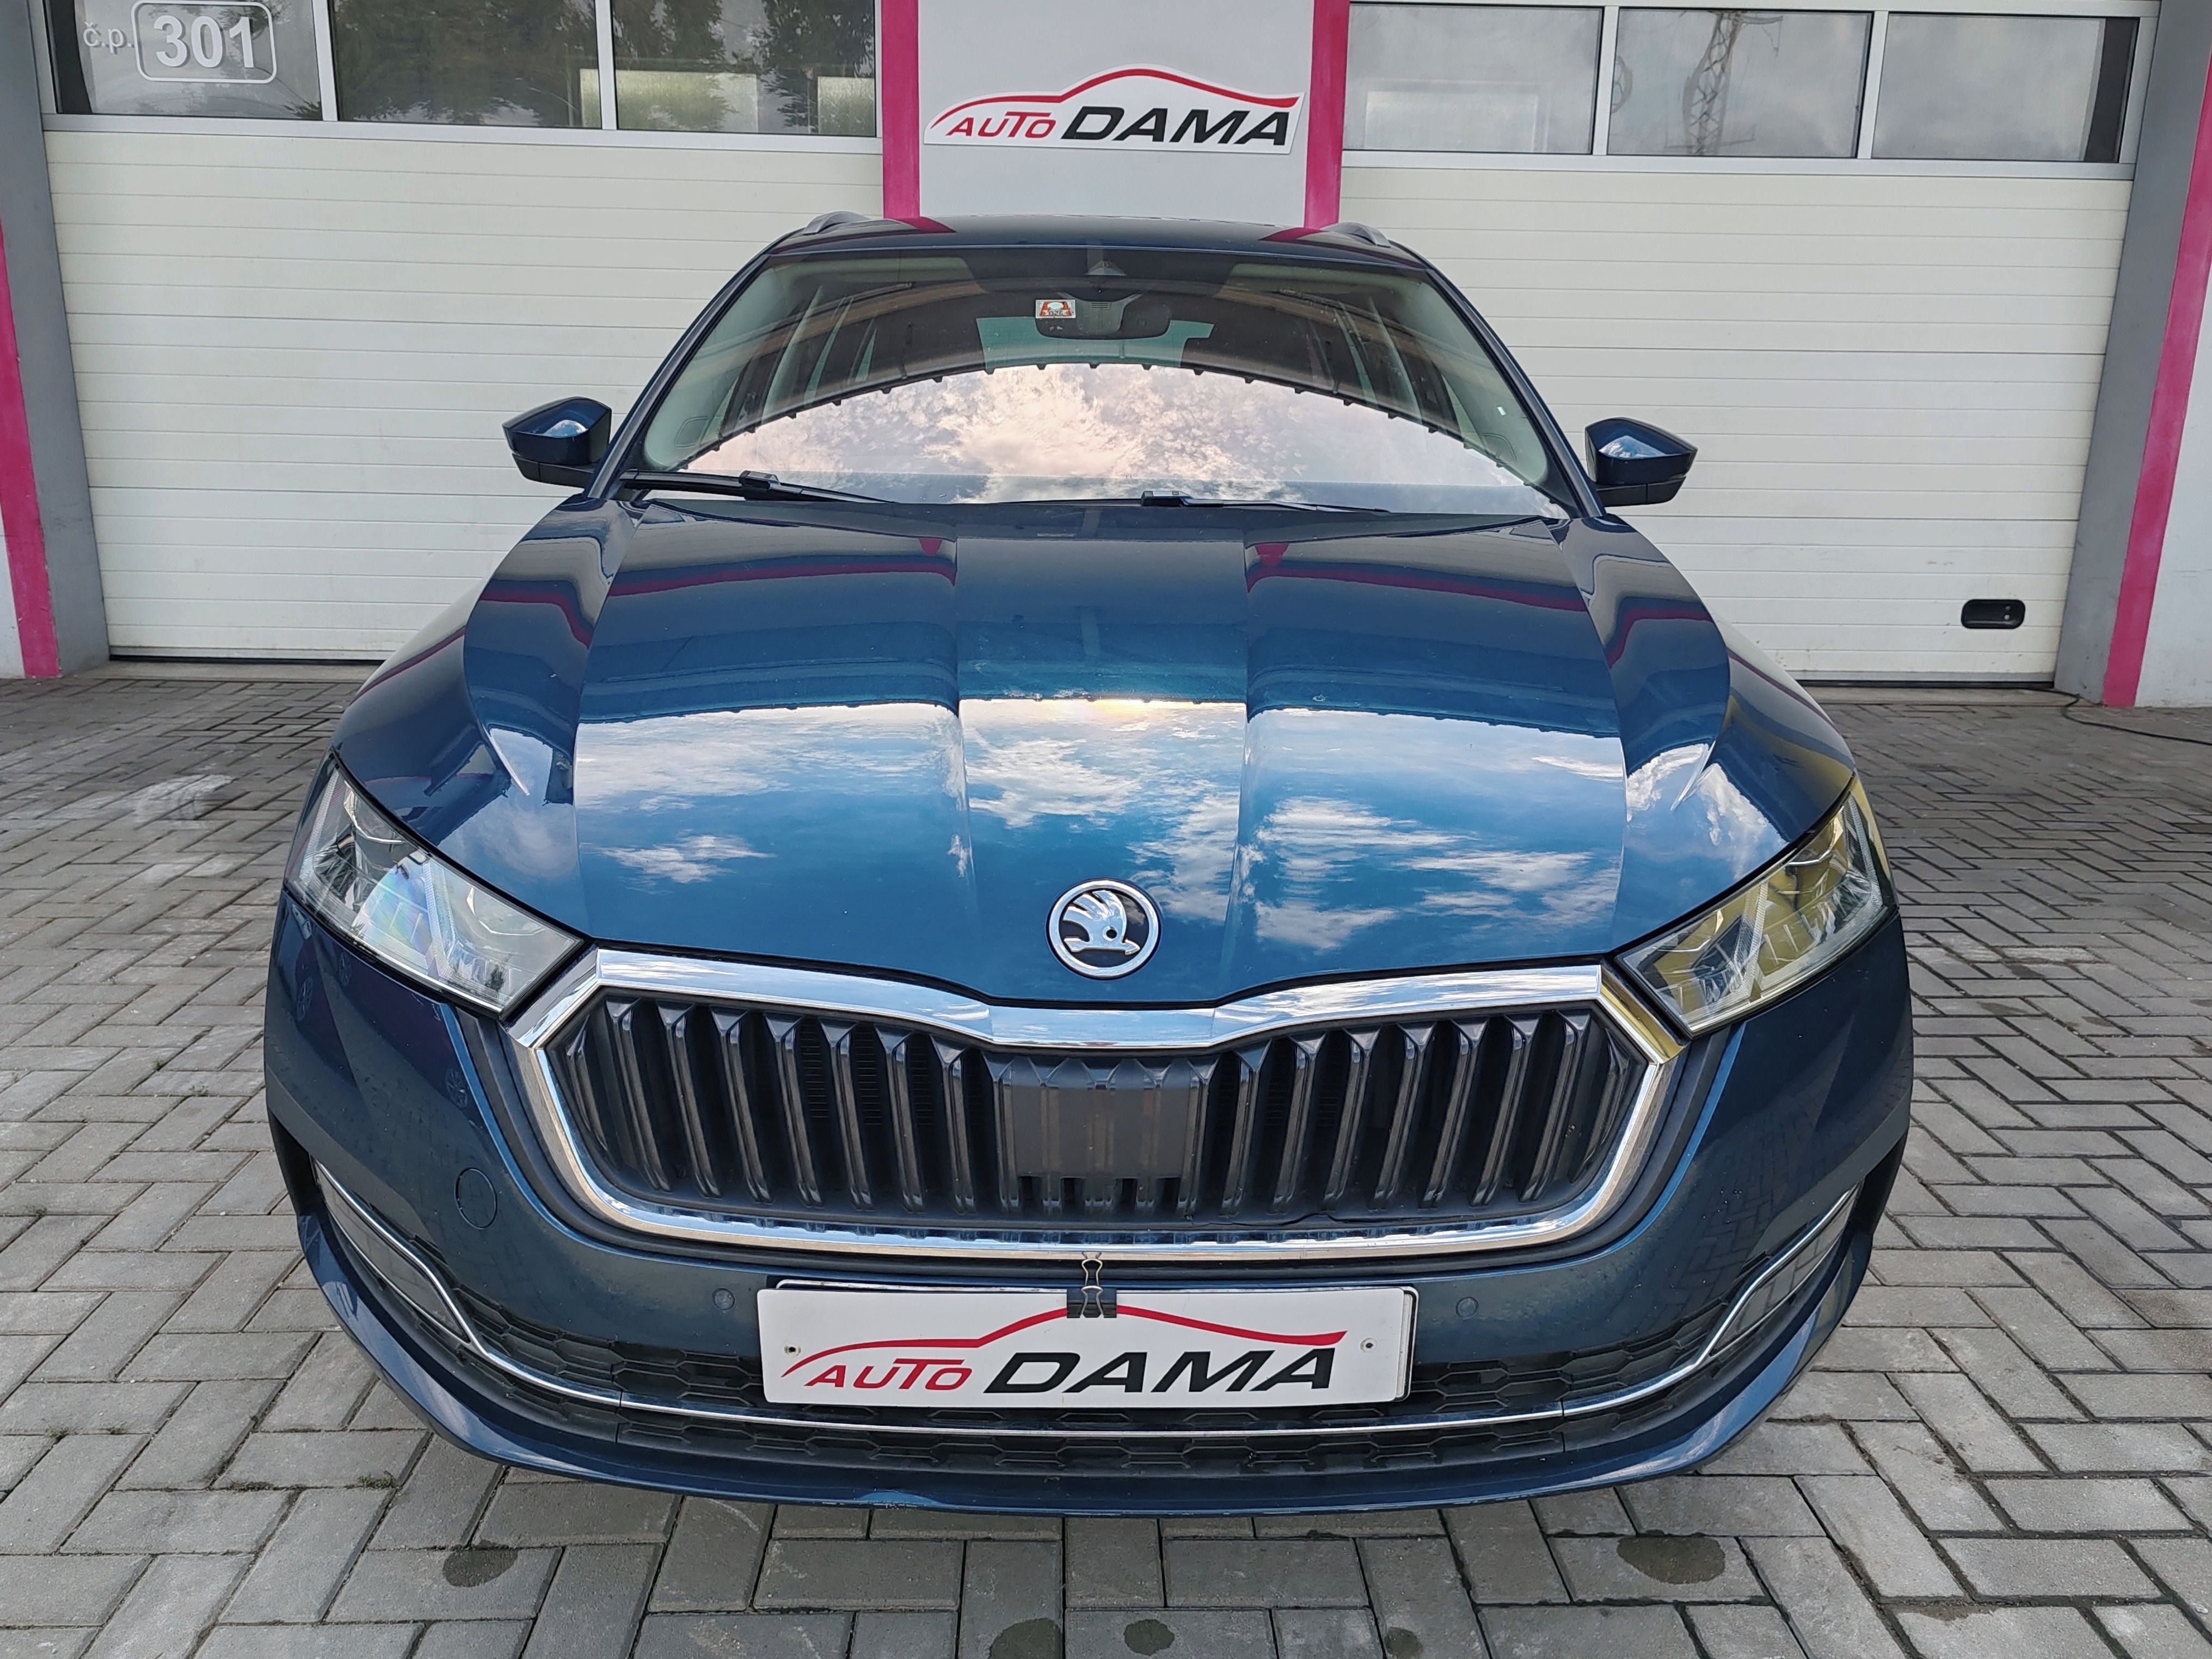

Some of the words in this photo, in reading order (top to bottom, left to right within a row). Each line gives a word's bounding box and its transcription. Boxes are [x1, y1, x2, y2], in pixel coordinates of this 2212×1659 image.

[83, 21, 133, 53] č.p.
[153, 15, 254, 69] 301
[945, 111, 1056, 139] AUTO
[1061, 106, 1290, 146] DAMA
[804, 1358, 973, 1391] AUTO
[982, 1347, 1336, 1394] DAMA
